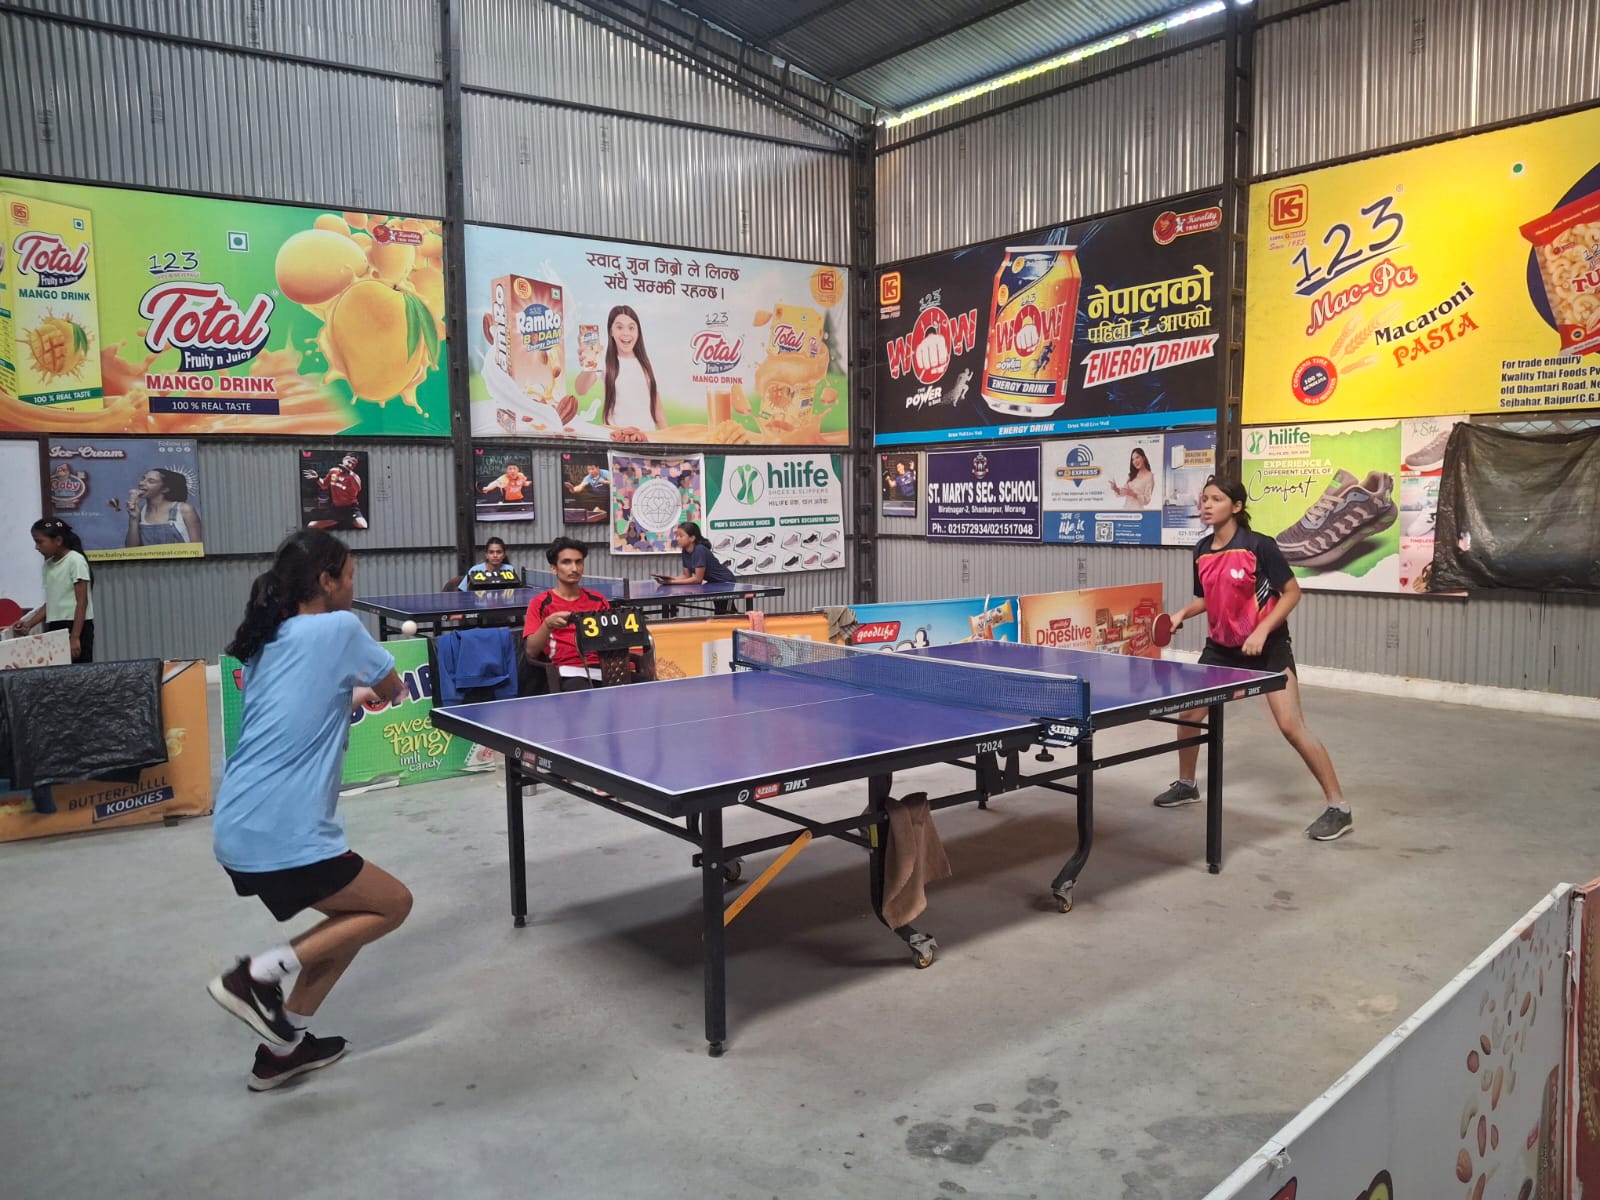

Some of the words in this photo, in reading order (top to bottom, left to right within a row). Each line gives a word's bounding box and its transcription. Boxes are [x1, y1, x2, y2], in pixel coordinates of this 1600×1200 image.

[1291, 195, 1405, 288] 123
[16, 233, 88, 274] Total
[149, 250, 199, 271] 123
[585, 252, 622, 270] स्वाद
[626, 256, 650, 275] जुन
[655, 257, 682, 276] जिब्रो
[687, 260, 701, 278] ले
[705, 263, 740, 281] लिन्छ
[19, 288, 58, 299] MANGO
[61, 290, 91, 301] DRINK
[1087, 264, 1214, 319] नेपालको
[1305, 258, 1418, 336] Mac-Pa
[145, 286, 270, 349] Total
[705, 312, 729, 323] 123
[1374, 281, 1475, 345] Macaroni
[995, 303, 1066, 357] WOW
[1087, 317, 1132, 344] पहिलो
[1140, 319, 1152, 336] र
[1156, 305, 1213, 333] आफ्नो
[773, 323, 806, 350] Total
[886, 308, 978, 384] WOW
[1392, 312, 1479, 368] PASTA
[693, 332, 742, 363] Total
[185, 351, 214, 369] Fruity
[216, 358, 224, 366] n
[227, 350, 252, 364] Juicy
[1086, 344, 1155, 385] ENERGY
[1155, 337, 1214, 367] DRINK
[1502, 360, 1516, 369] For
[1517, 358, 1542, 368] trade
[1544, 356, 1581, 367] enquiry
[146, 375, 214, 391] MANGO
[220, 377, 276, 393] DRINK
[692, 375, 719, 383] MANGO
[721, 376, 743, 385] DRINK
[1501, 371, 1535, 382] Kwality
[1537, 369, 1557, 379] Thai
[1559, 367, 1587, 378] Foods
[992, 378, 1021, 392] ENERGY
[1022, 382, 1050, 394] DRINK
[1500, 386, 1514, 395] old
[1517, 382, 1560, 394] Dhamtari
[34, 395, 48, 404] 100
[56, 392, 72, 401] REAL
[74, 390, 91, 398] TASTE
[172, 401, 189, 411] 100
[191, 402, 200, 411] %
[202, 402, 224, 411] REAL
[226, 403, 251, 412] TASTE
[905, 386, 943, 410] POWER
[998, 425, 1028, 436] ENERGY
[1029, 423, 1056, 433] DRINK
[1268, 427, 1311, 446] hilife
[767, 460, 829, 489] hilife
[1072, 469, 1098, 477] EXPRESS
[1263, 460, 1323, 469] EXPERIENCE
[928, 483, 940, 503] ST.
[942, 481, 974, 503] MARY'S
[975, 481, 996, 503] SEC.
[998, 480, 1038, 503] SCHOOL
[1248, 470, 1318, 502] Comfort
[938, 505, 971, 515] Biratnagar-2,
[971, 505, 1003, 515] Shankarpur,
[1005, 505, 1026, 516] Morang
[948, 523, 1034, 535] 021572934/021517048
[474, 572, 486, 580] 4
[500, 571, 515, 580] 10
[583, 617, 600, 637] 3
[624, 613, 639, 632] 4
[857, 625, 895, 642] goodlife
[1036, 625, 1092, 647] Digestive
[384, 717, 432, 738] swee
[391, 728, 453, 757] tangy
[976, 739, 1003, 753] T2024
[400, 750, 420, 766] imli
[410, 758, 443, 772] candy
[784, 778, 810, 792] DHS
[106, 790, 163, 815] KOOKIES
